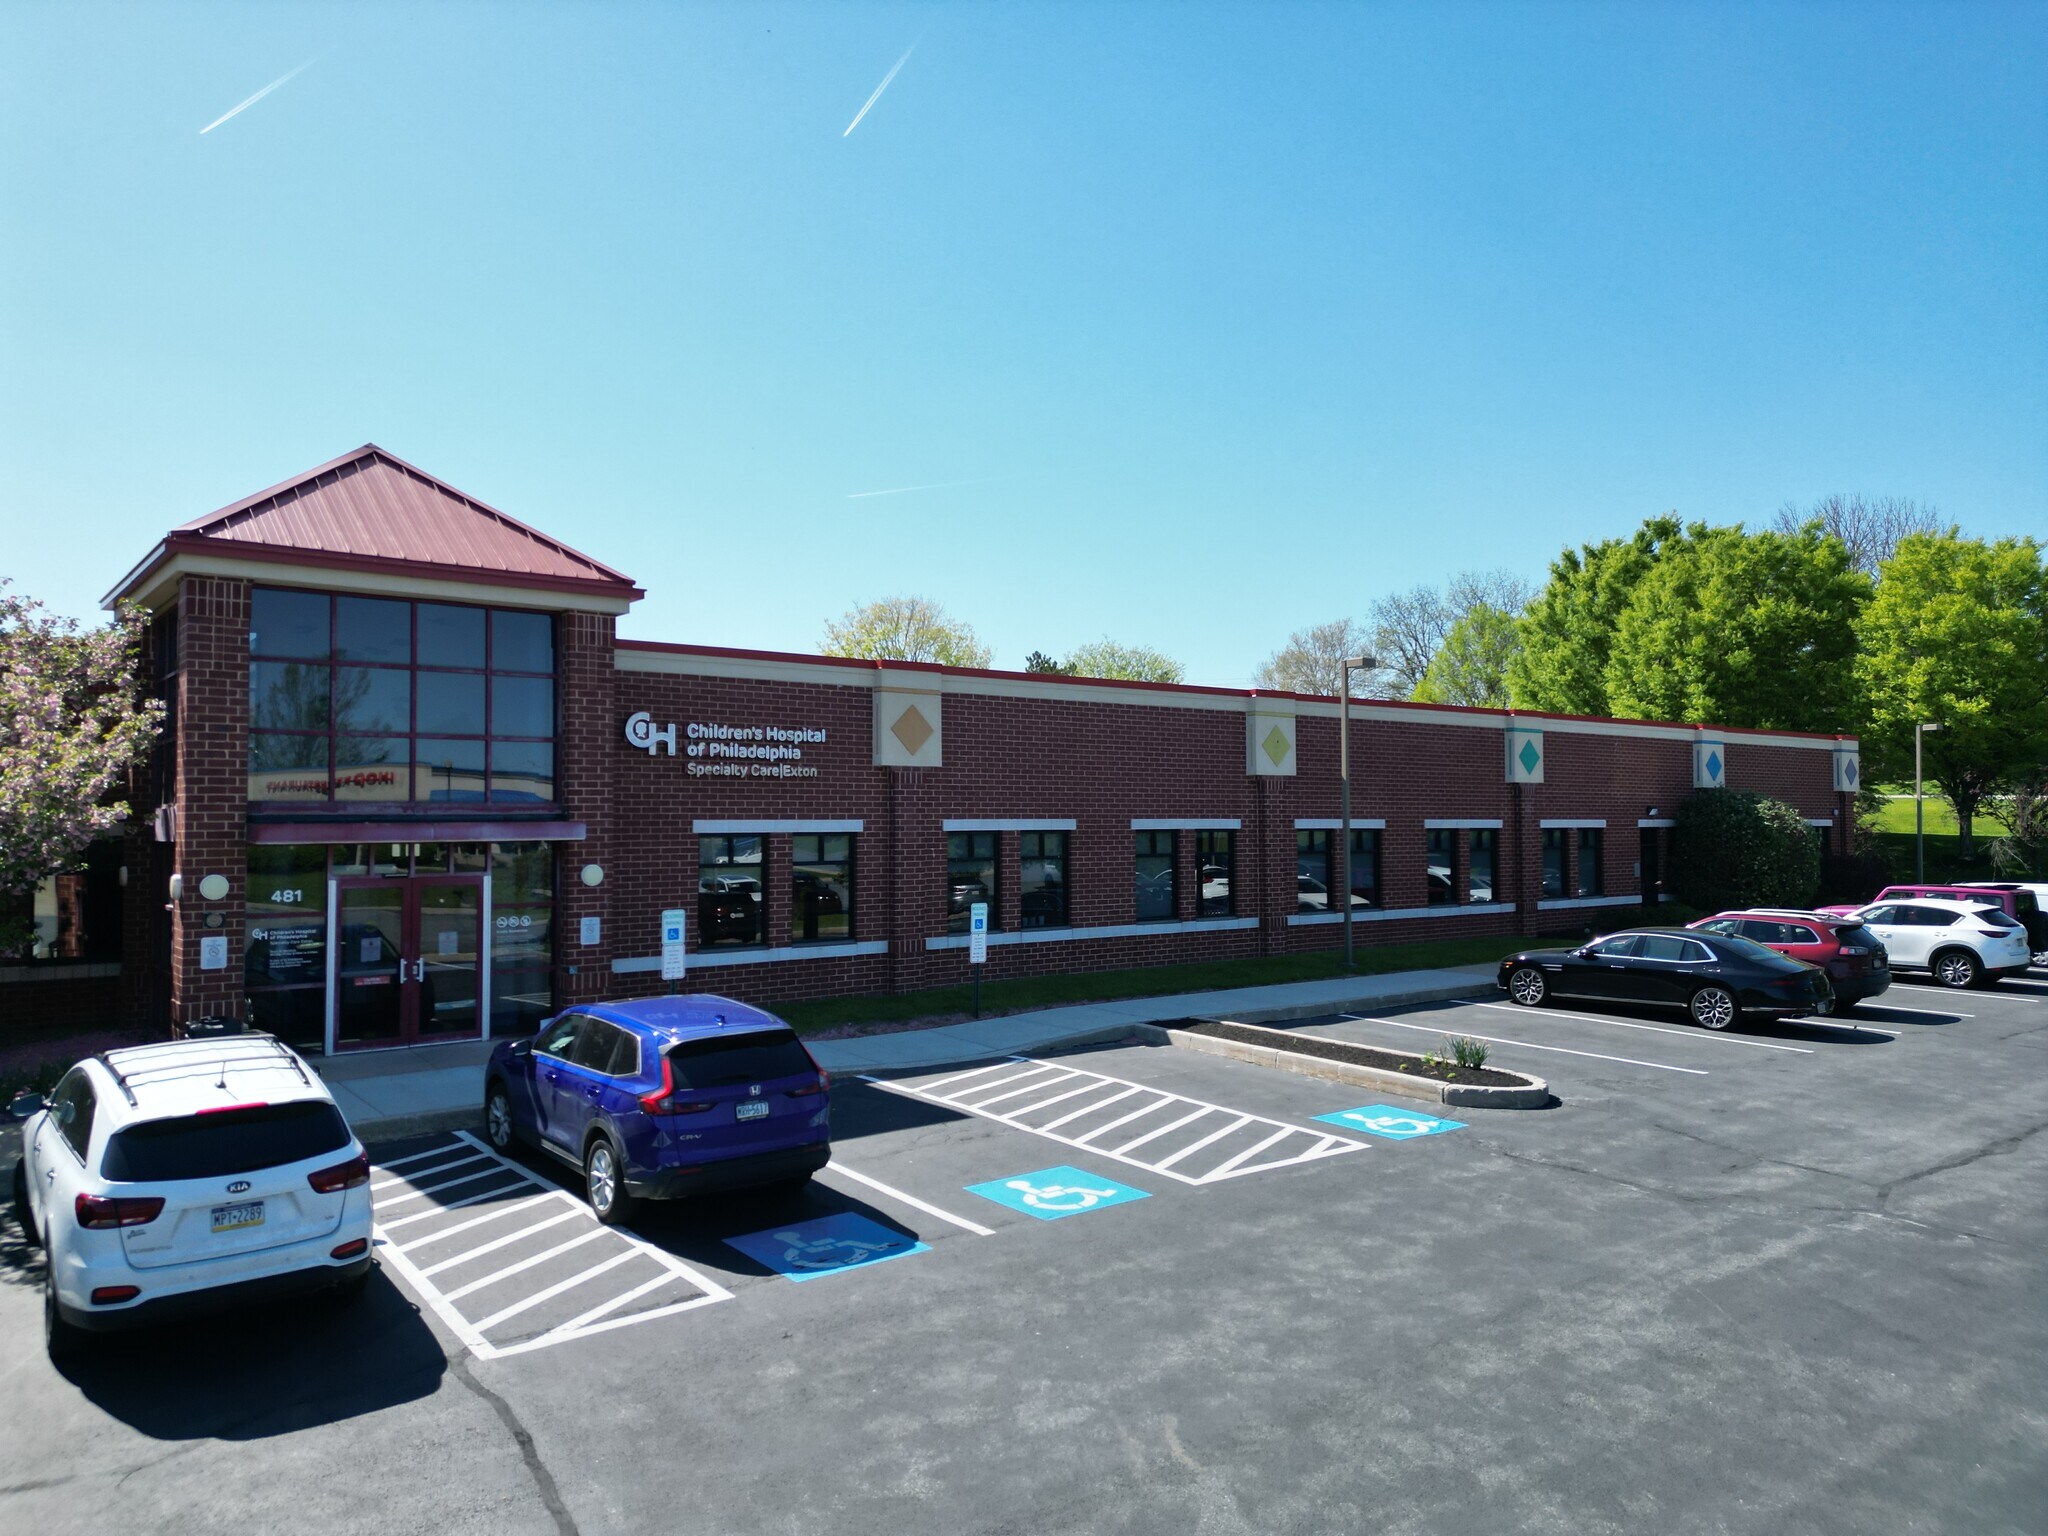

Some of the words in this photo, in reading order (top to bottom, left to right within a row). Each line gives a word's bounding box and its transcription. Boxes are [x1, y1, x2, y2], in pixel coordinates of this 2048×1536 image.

[687, 723, 763, 741] Children's
[766, 726, 826, 744] Hospital
[687, 743, 706, 757] of
[709, 743, 801, 761] Philadelphia
[687, 762, 748, 778] Specialty
[271, 889, 302, 903] 481
[229, 1182, 249, 1192] KIA
